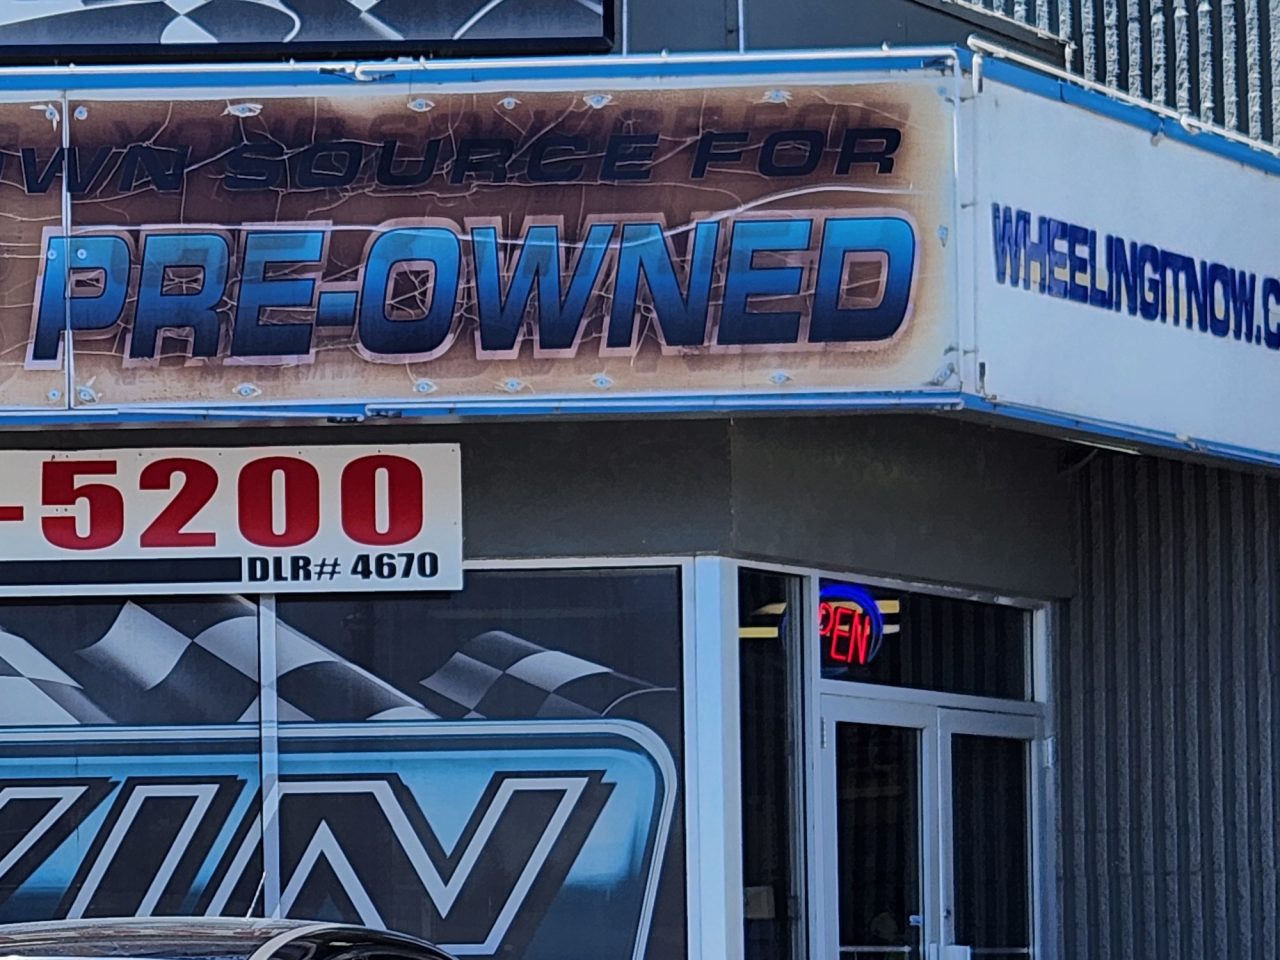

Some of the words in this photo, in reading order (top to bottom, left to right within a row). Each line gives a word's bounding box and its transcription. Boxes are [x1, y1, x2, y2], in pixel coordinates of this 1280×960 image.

[222, 132, 660, 195] SOURCE
[690, 127, 902, 179] FOR
[25, 213, 920, 371] PRE-OWNED
[247, 556, 342, 582] DLR#
[350, 552, 439, 580] 4670
[818, 602, 871, 664] PEN
